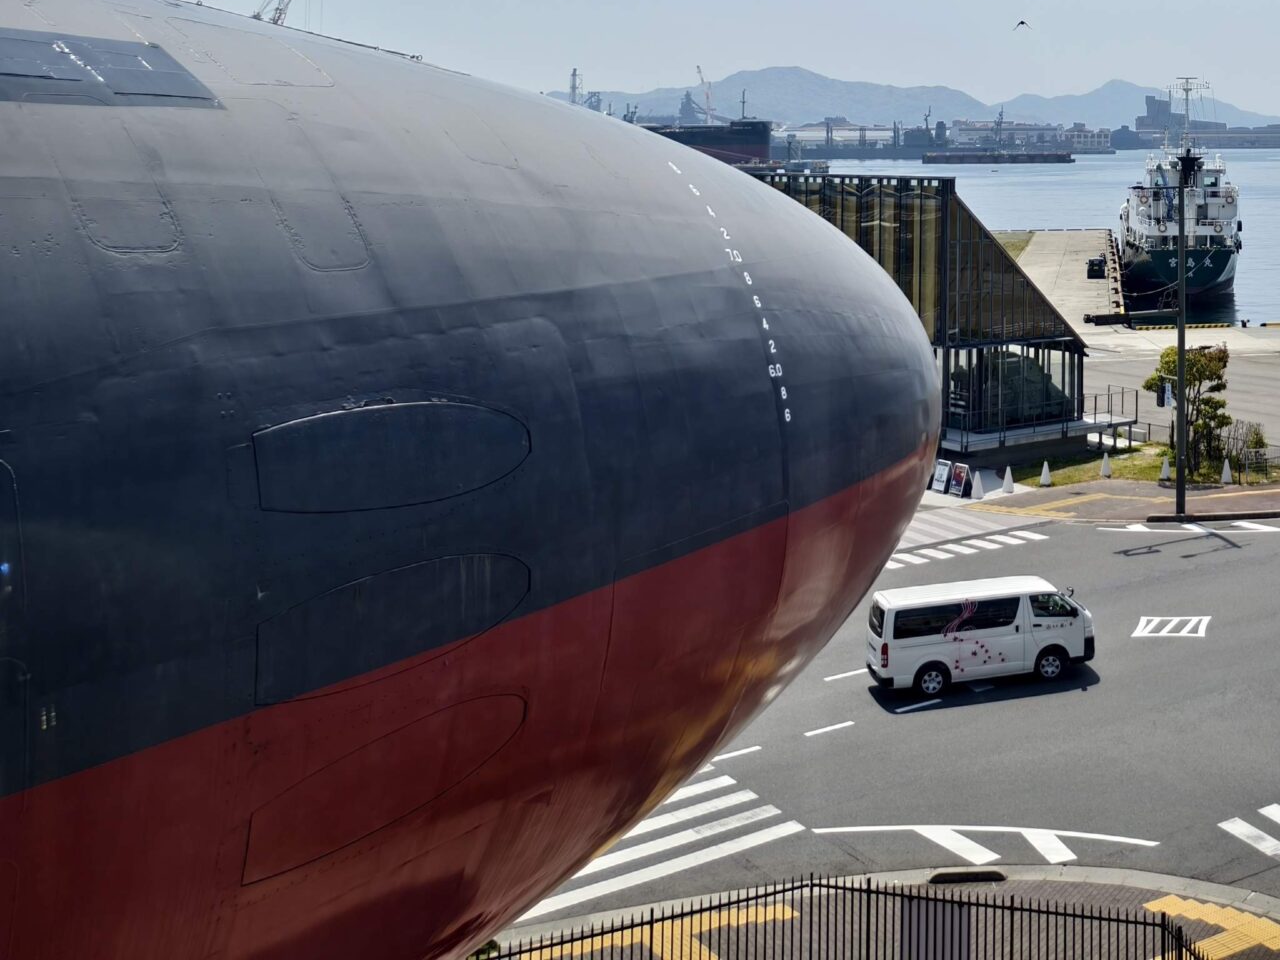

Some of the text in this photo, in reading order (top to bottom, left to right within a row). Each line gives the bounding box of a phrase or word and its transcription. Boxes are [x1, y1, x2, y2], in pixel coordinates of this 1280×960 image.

[720, 227, 731, 240] 2
[743, 271, 753, 285] 8
[753, 295, 762, 308] 6
[762, 317, 769, 330] 4
[768, 339, 777, 353] 2
[780, 386, 788, 400] 8
[784, 408, 792, 422] 6
